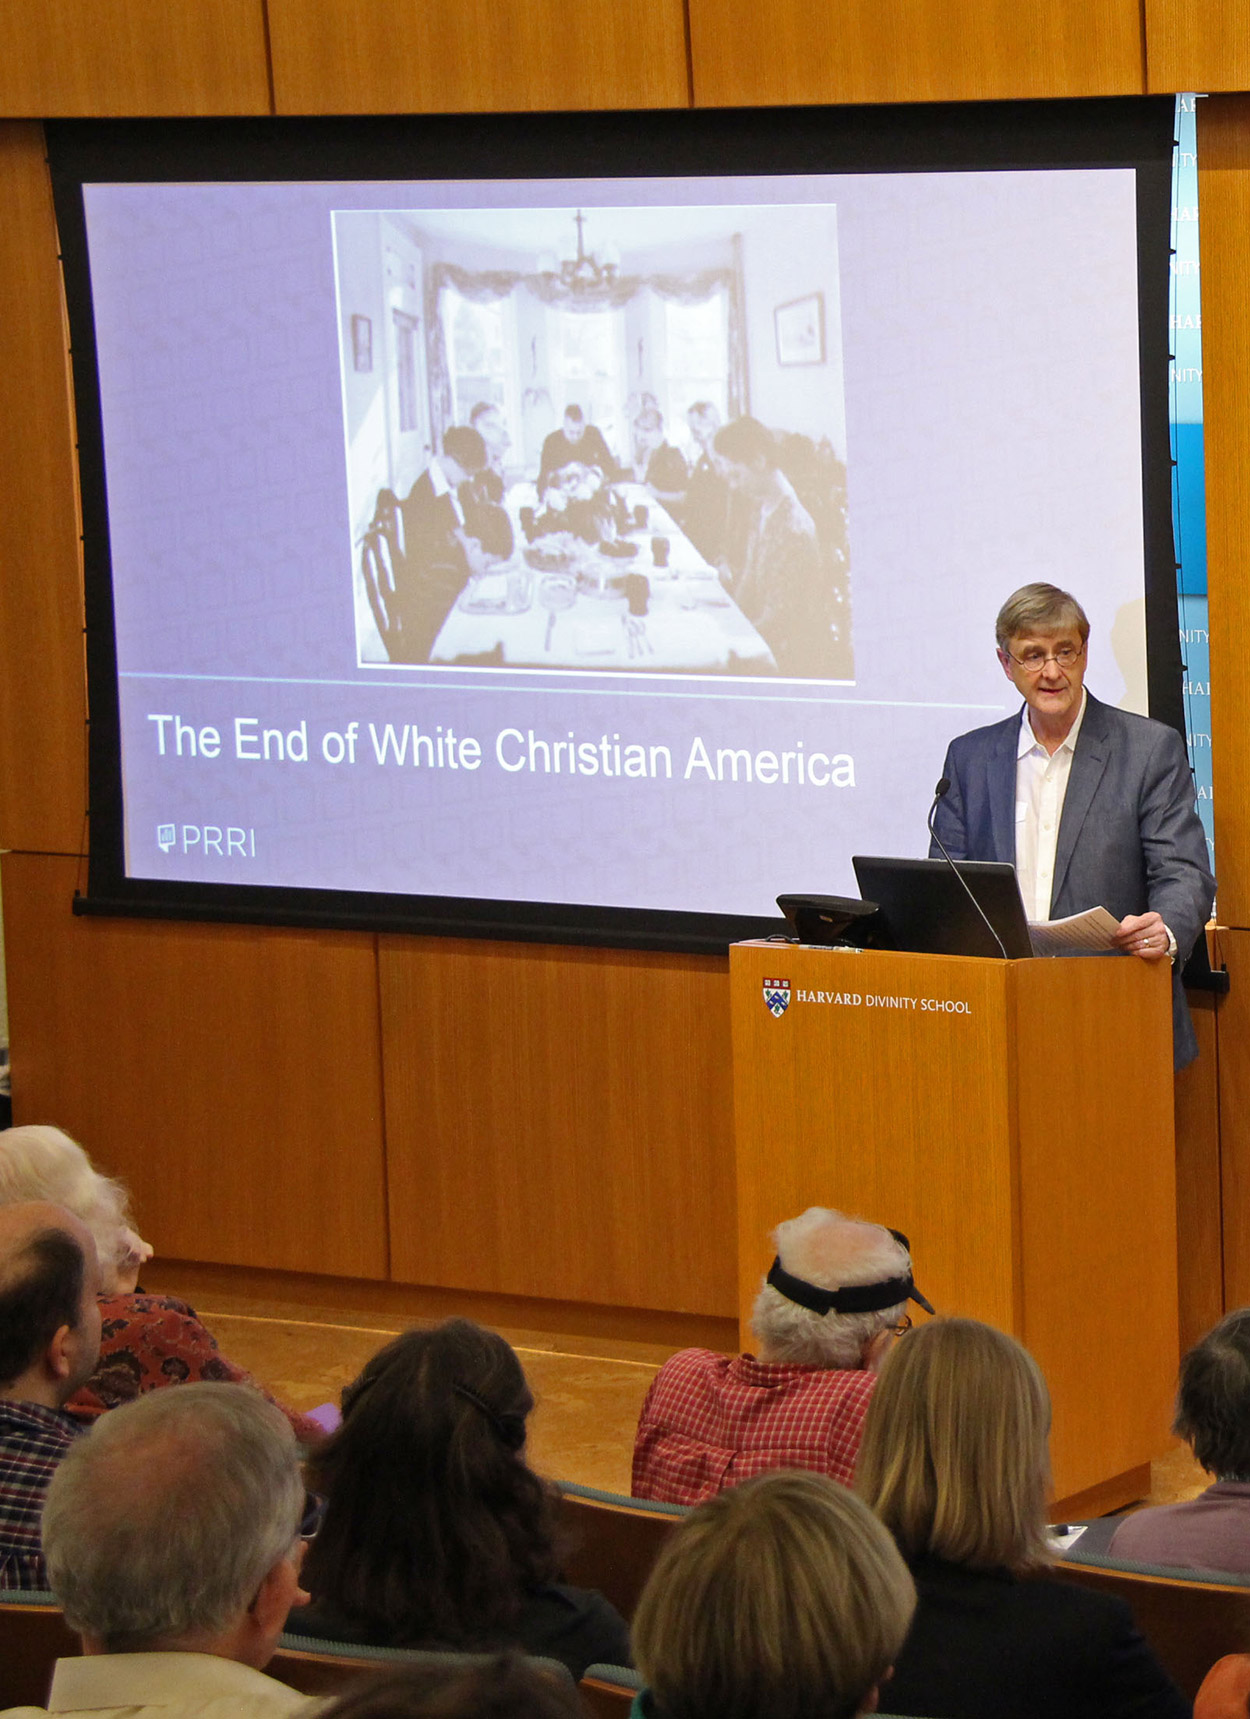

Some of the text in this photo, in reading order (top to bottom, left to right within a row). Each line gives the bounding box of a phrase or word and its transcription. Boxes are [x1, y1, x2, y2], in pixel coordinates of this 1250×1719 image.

[147, 714, 855, 787] The End of White Christian America
[183, 825, 255, 857] PRRI
[797, 990, 971, 1014] HARVARD DIVINITY SCHOOL
